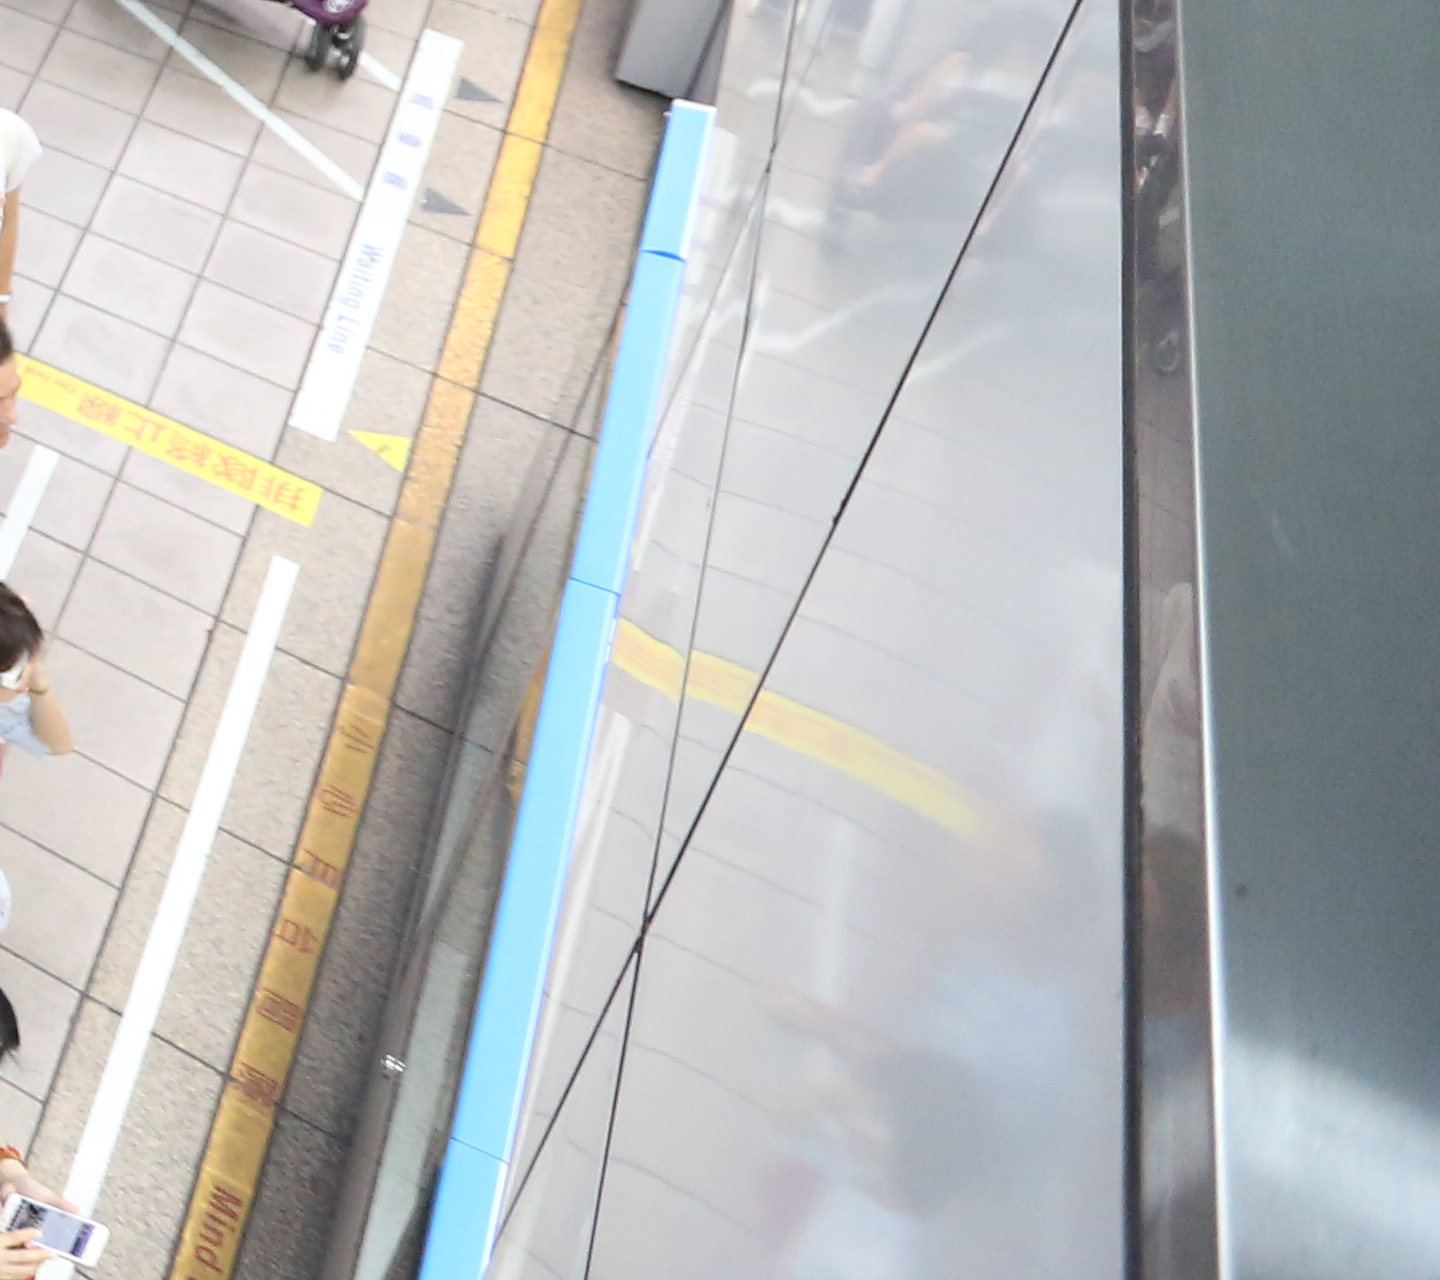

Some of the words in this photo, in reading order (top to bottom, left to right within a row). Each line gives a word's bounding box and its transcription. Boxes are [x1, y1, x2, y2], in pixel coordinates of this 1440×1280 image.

[337, 243, 383, 308] Waiting
[327, 314, 361, 354] Line
[77, 396, 307, 511] 排隊終止線
[193, 1184, 244, 1275] Mind
